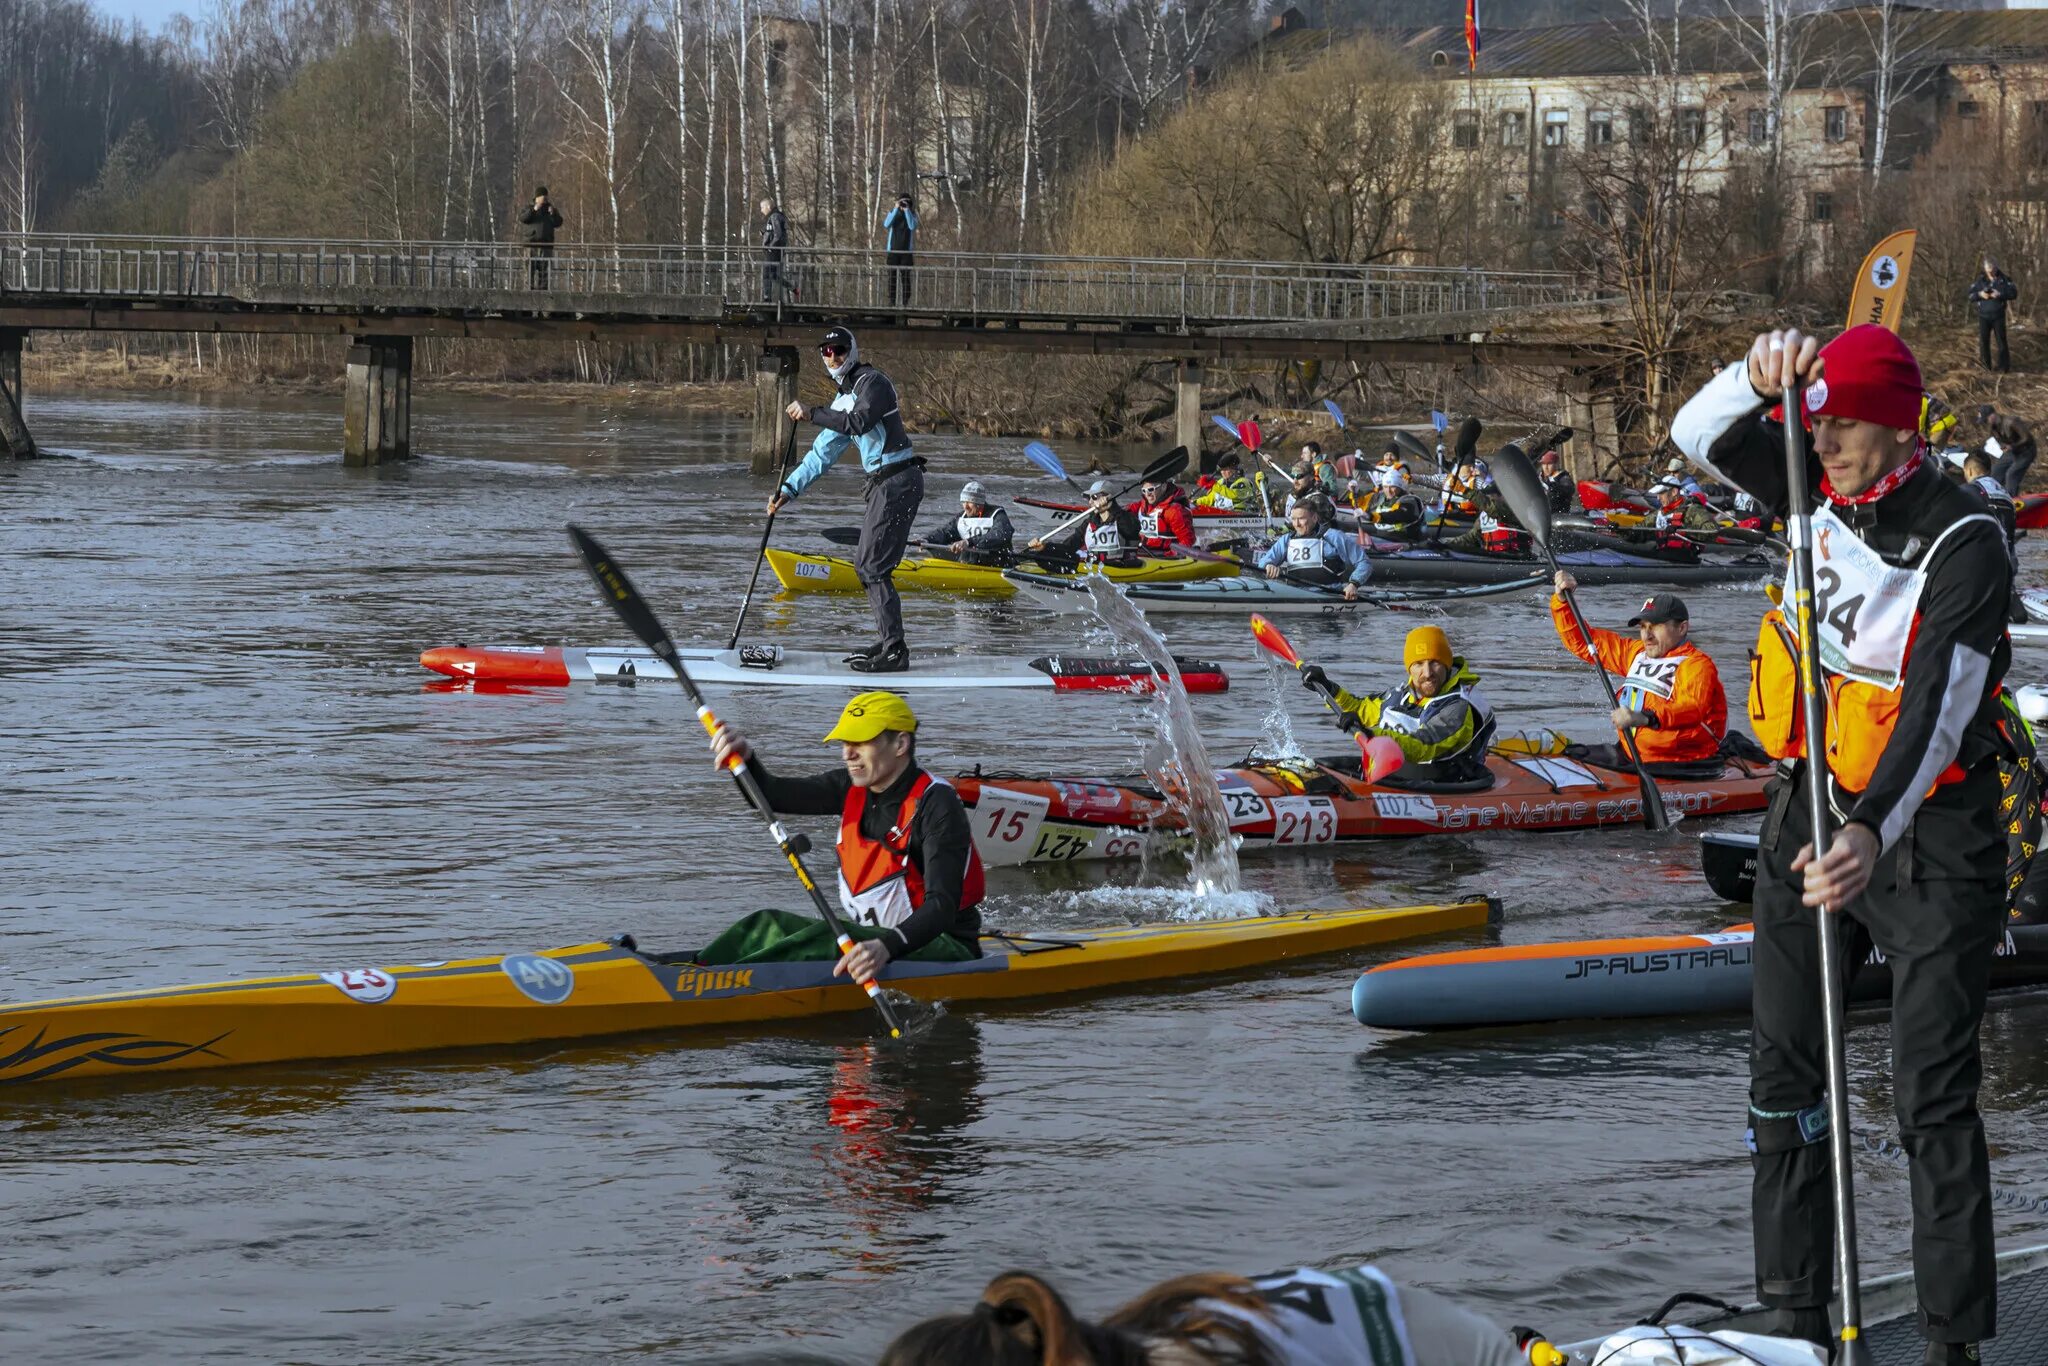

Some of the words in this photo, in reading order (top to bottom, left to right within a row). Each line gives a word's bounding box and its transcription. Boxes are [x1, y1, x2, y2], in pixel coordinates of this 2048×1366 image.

[1092, 530, 1117, 545] 107
[1292, 546, 1311, 561] 28
[796, 562, 816, 577] 107
[1816, 566, 1866, 648] 34
[1377, 794, 1413, 817] 102
[987, 807, 1029, 842] 15
[1277, 810, 1334, 844] 213
[1034, 832, 1088, 861] 421
[517, 959, 566, 990] 40
